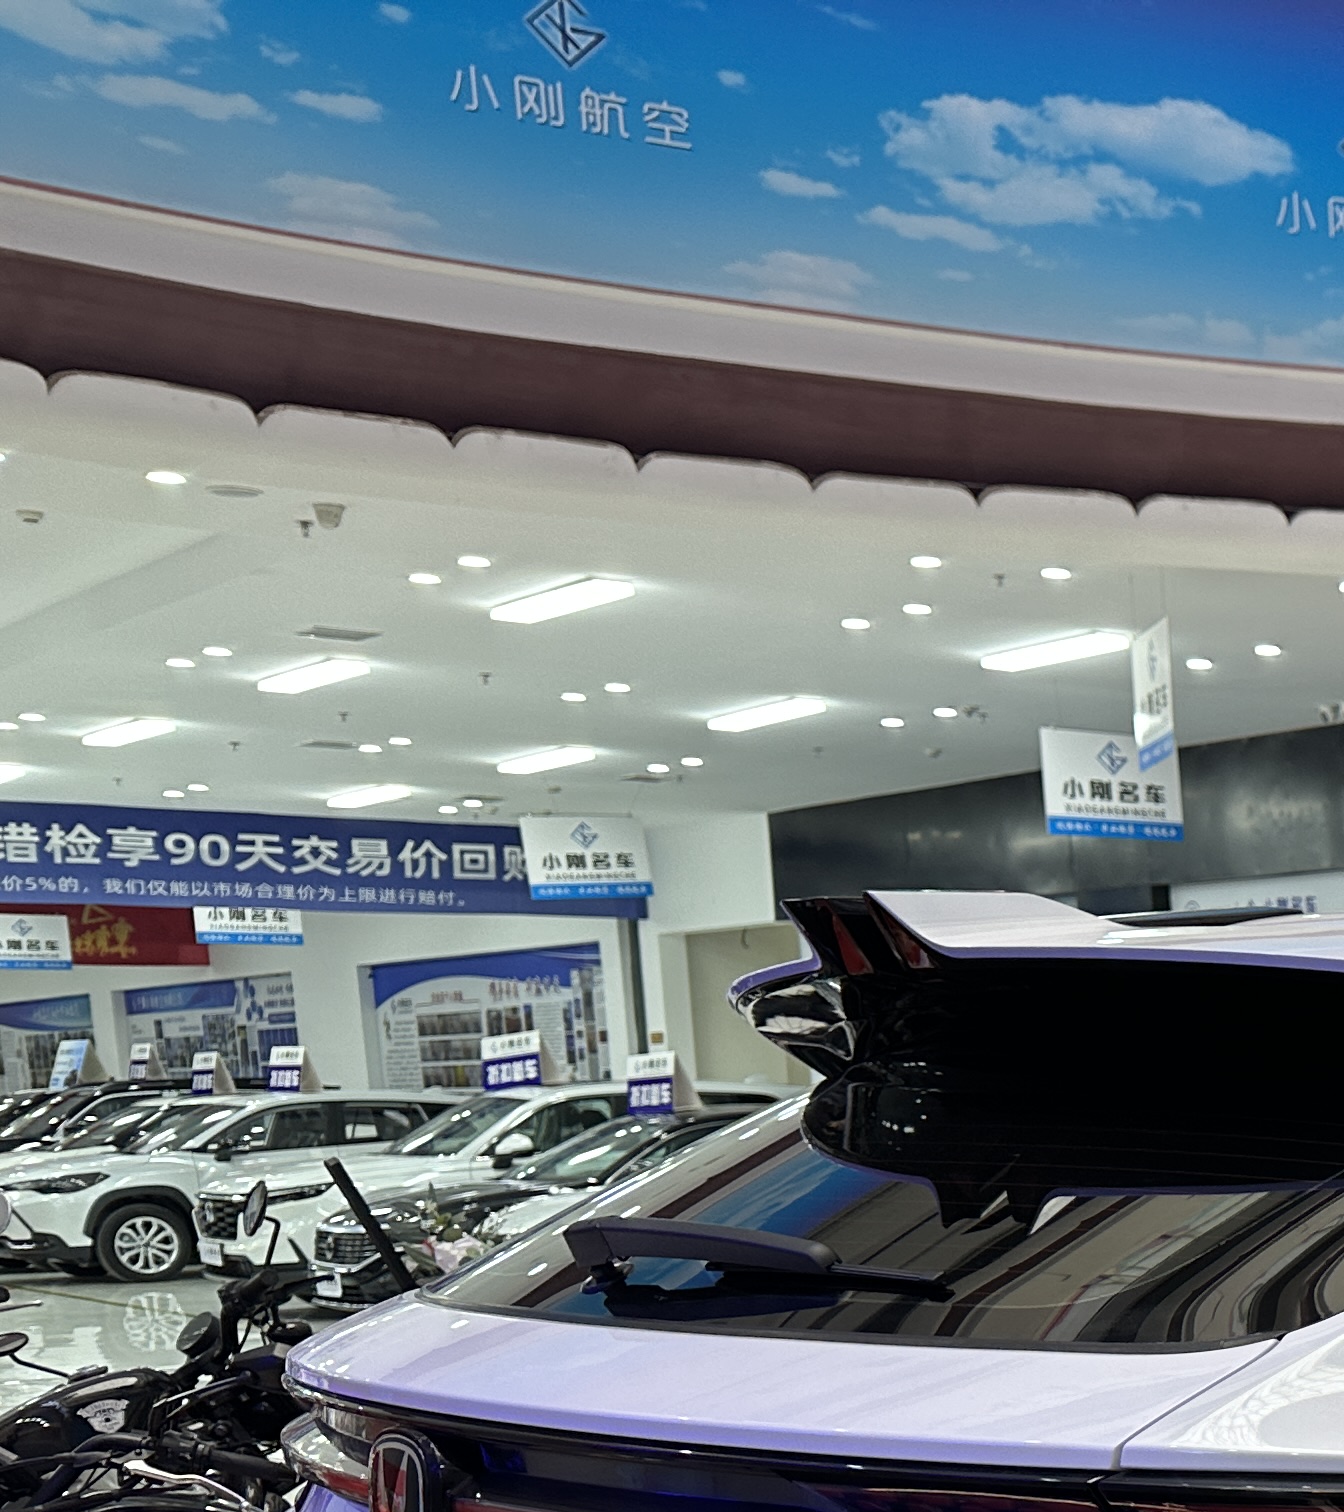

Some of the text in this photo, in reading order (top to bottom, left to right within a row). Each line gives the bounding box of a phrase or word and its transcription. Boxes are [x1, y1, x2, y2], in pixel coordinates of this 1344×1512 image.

[450, 64, 692, 150] 小刚航空
[1063, 777, 1166, 805] 小刚名车
